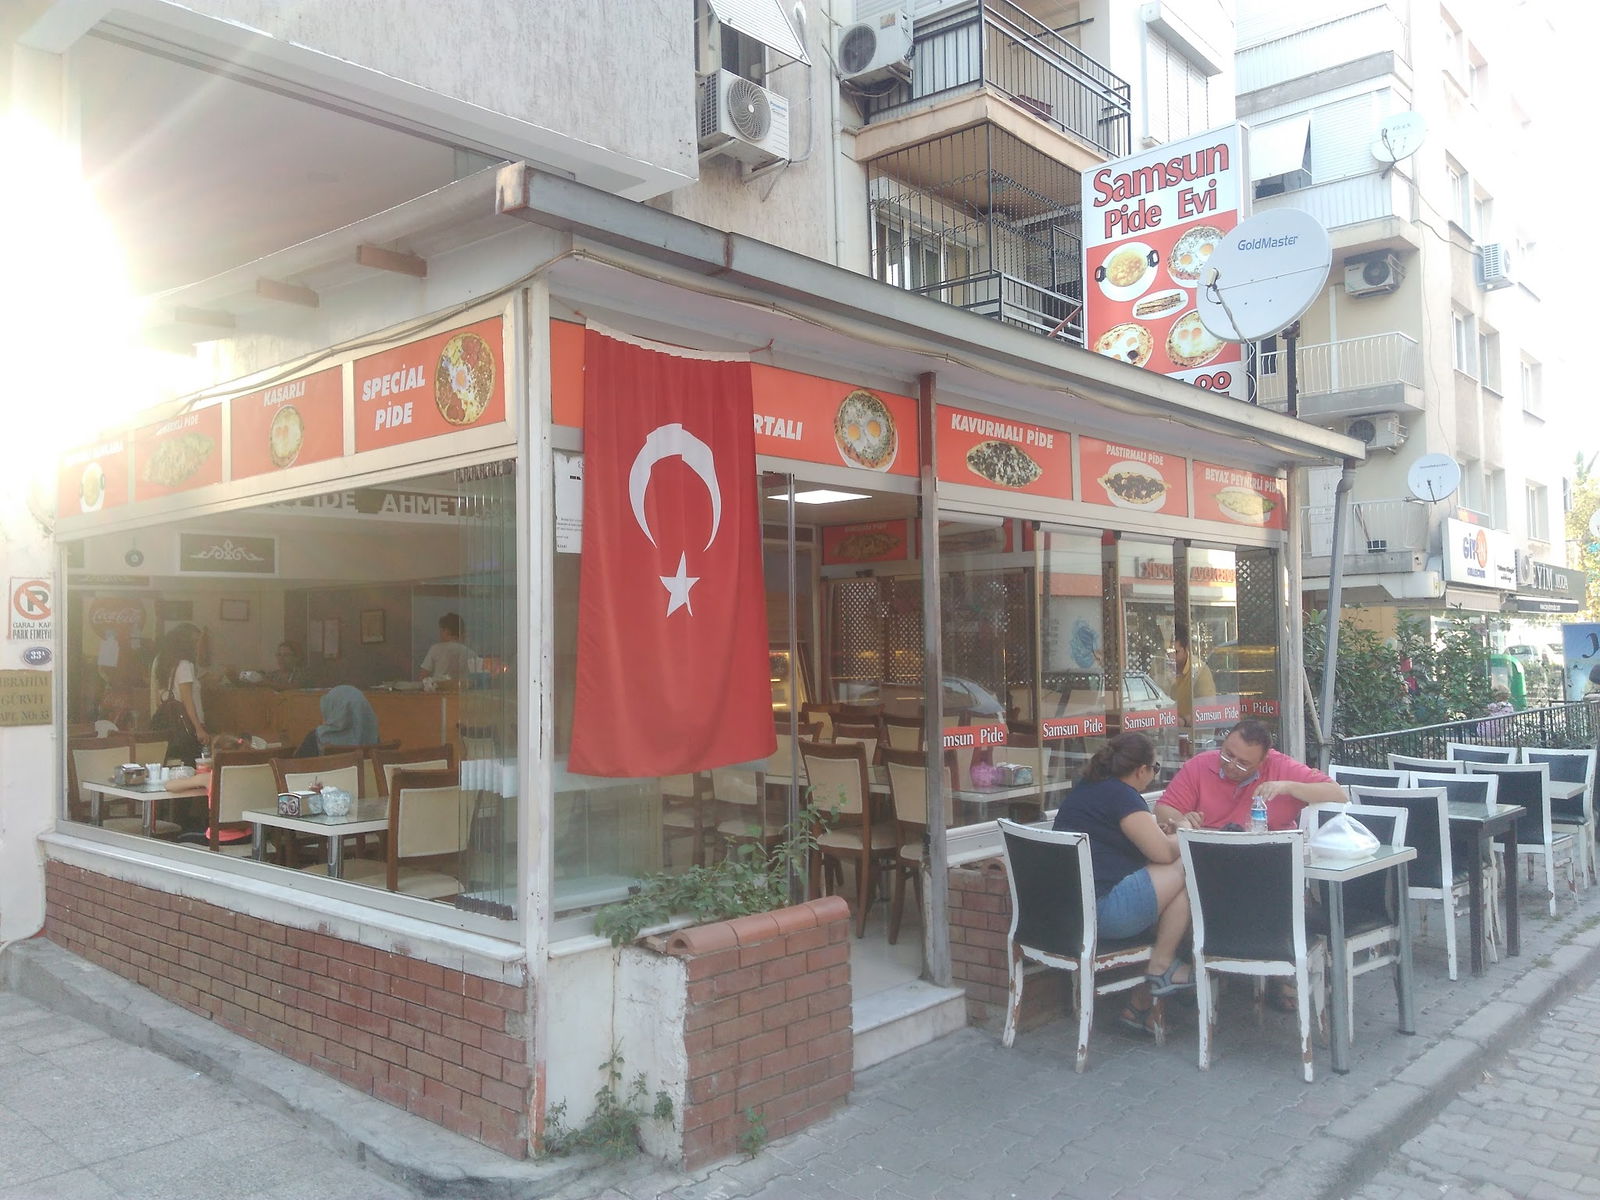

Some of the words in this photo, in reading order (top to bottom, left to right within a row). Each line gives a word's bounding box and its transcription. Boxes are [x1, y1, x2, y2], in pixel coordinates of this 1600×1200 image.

[1092, 143, 1230, 208] Samsun
[1104, 201, 1162, 239] Pide
[1177, 179, 1217, 220] Evi
[1237, 235, 1298, 251] GoldMaster
[361, 365, 426, 402] SPECİAL
[374, 400, 414, 431] PİDE
[753, 413, 804, 441] RTALI
[951, 413, 1024, 443] KAVURMALI
[1026, 427, 1054, 449] PİDE
[1106, 444, 1147, 463] PASTIRMALI
[1148, 451, 1164, 465] PİDE
[1205, 467, 1230, 484] BEYAZ
[1195, 709, 1222, 722] Samsun
[1224, 706, 1239, 720] Pide
[1253, 702, 1274, 714] Pide
[1043, 722, 1079, 738] Samsun
[1083, 718, 1104, 733] Pide
[1124, 716, 1155, 730] Samsun
[1159, 712, 1176, 726] Pide
[943, 732, 974, 748] msun
[980, 727, 1004, 744] Pide
